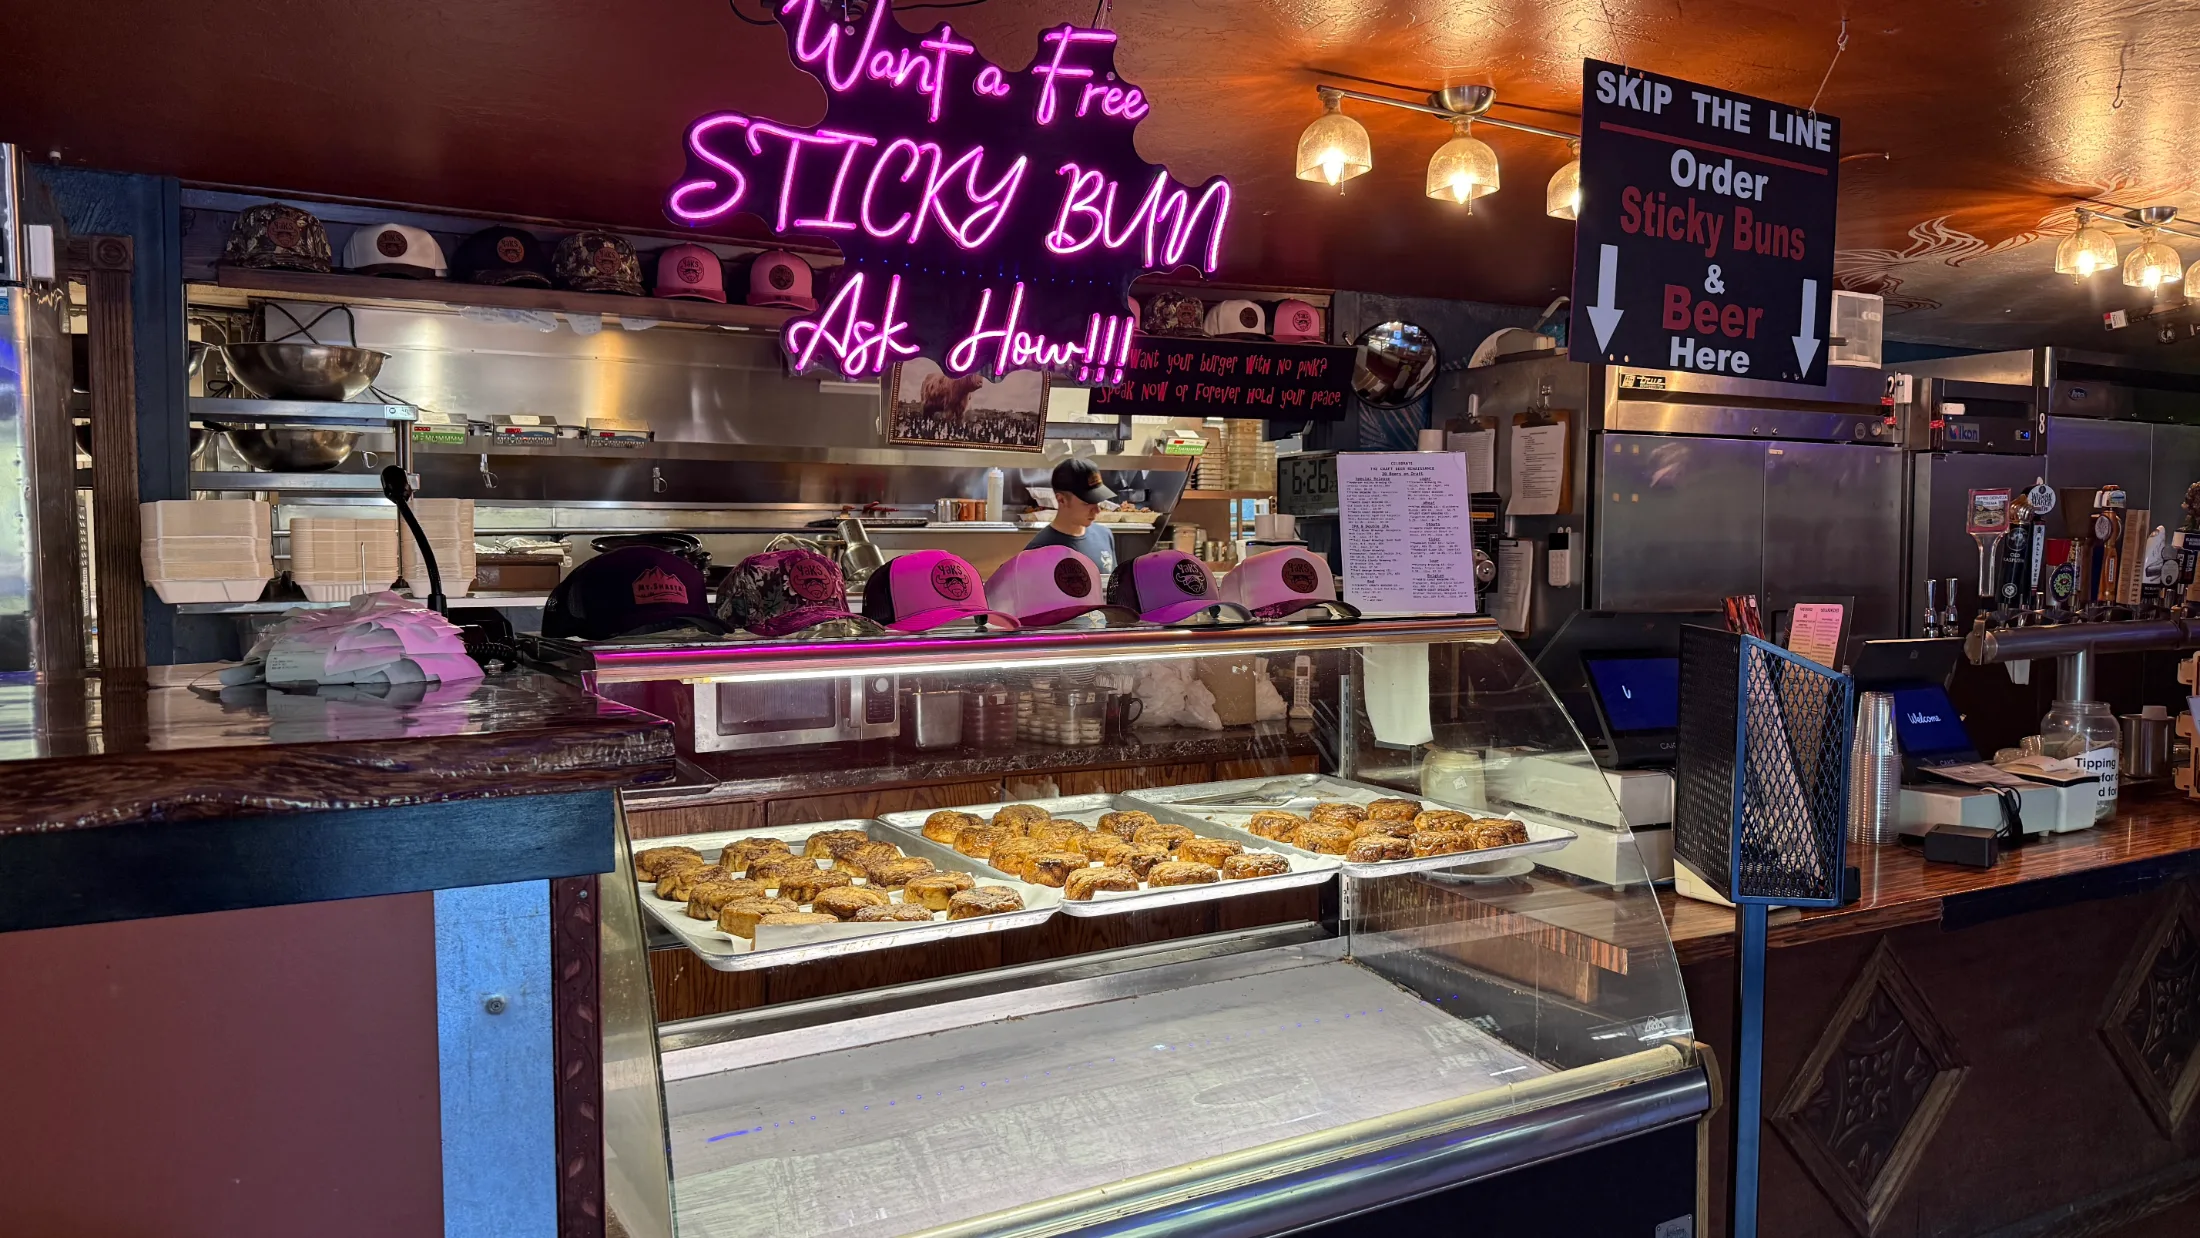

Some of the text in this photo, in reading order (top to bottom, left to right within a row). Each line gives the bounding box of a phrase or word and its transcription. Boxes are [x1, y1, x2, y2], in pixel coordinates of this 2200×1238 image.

[781, 0, 1150, 125] Want a Free
[1596, 70, 1831, 152] SKIP THE LINE
[1670, 148, 1769, 201] Order
[669, 115, 1232, 273] STICKY BUN
[1620, 185, 1806, 261] Sticky Buns
[1704, 264, 1726, 295] &
[787, 272, 1135, 383] Ask How!!!
[1662, 284, 1764, 339] Beer
[1166, 353, 1194, 374] your
[1200, 353, 1238, 376] burger
[1669, 336, 1750, 374] Here
[1175, 384, 1189, 402] or
[1279, 388, 1306, 409] your
[2038, 412, 2046, 434] 8
[1292, 459, 1328, 494] 6:26
[1907, 712, 1941, 724] Welcome
[2074, 758, 2116, 770] Tipping
